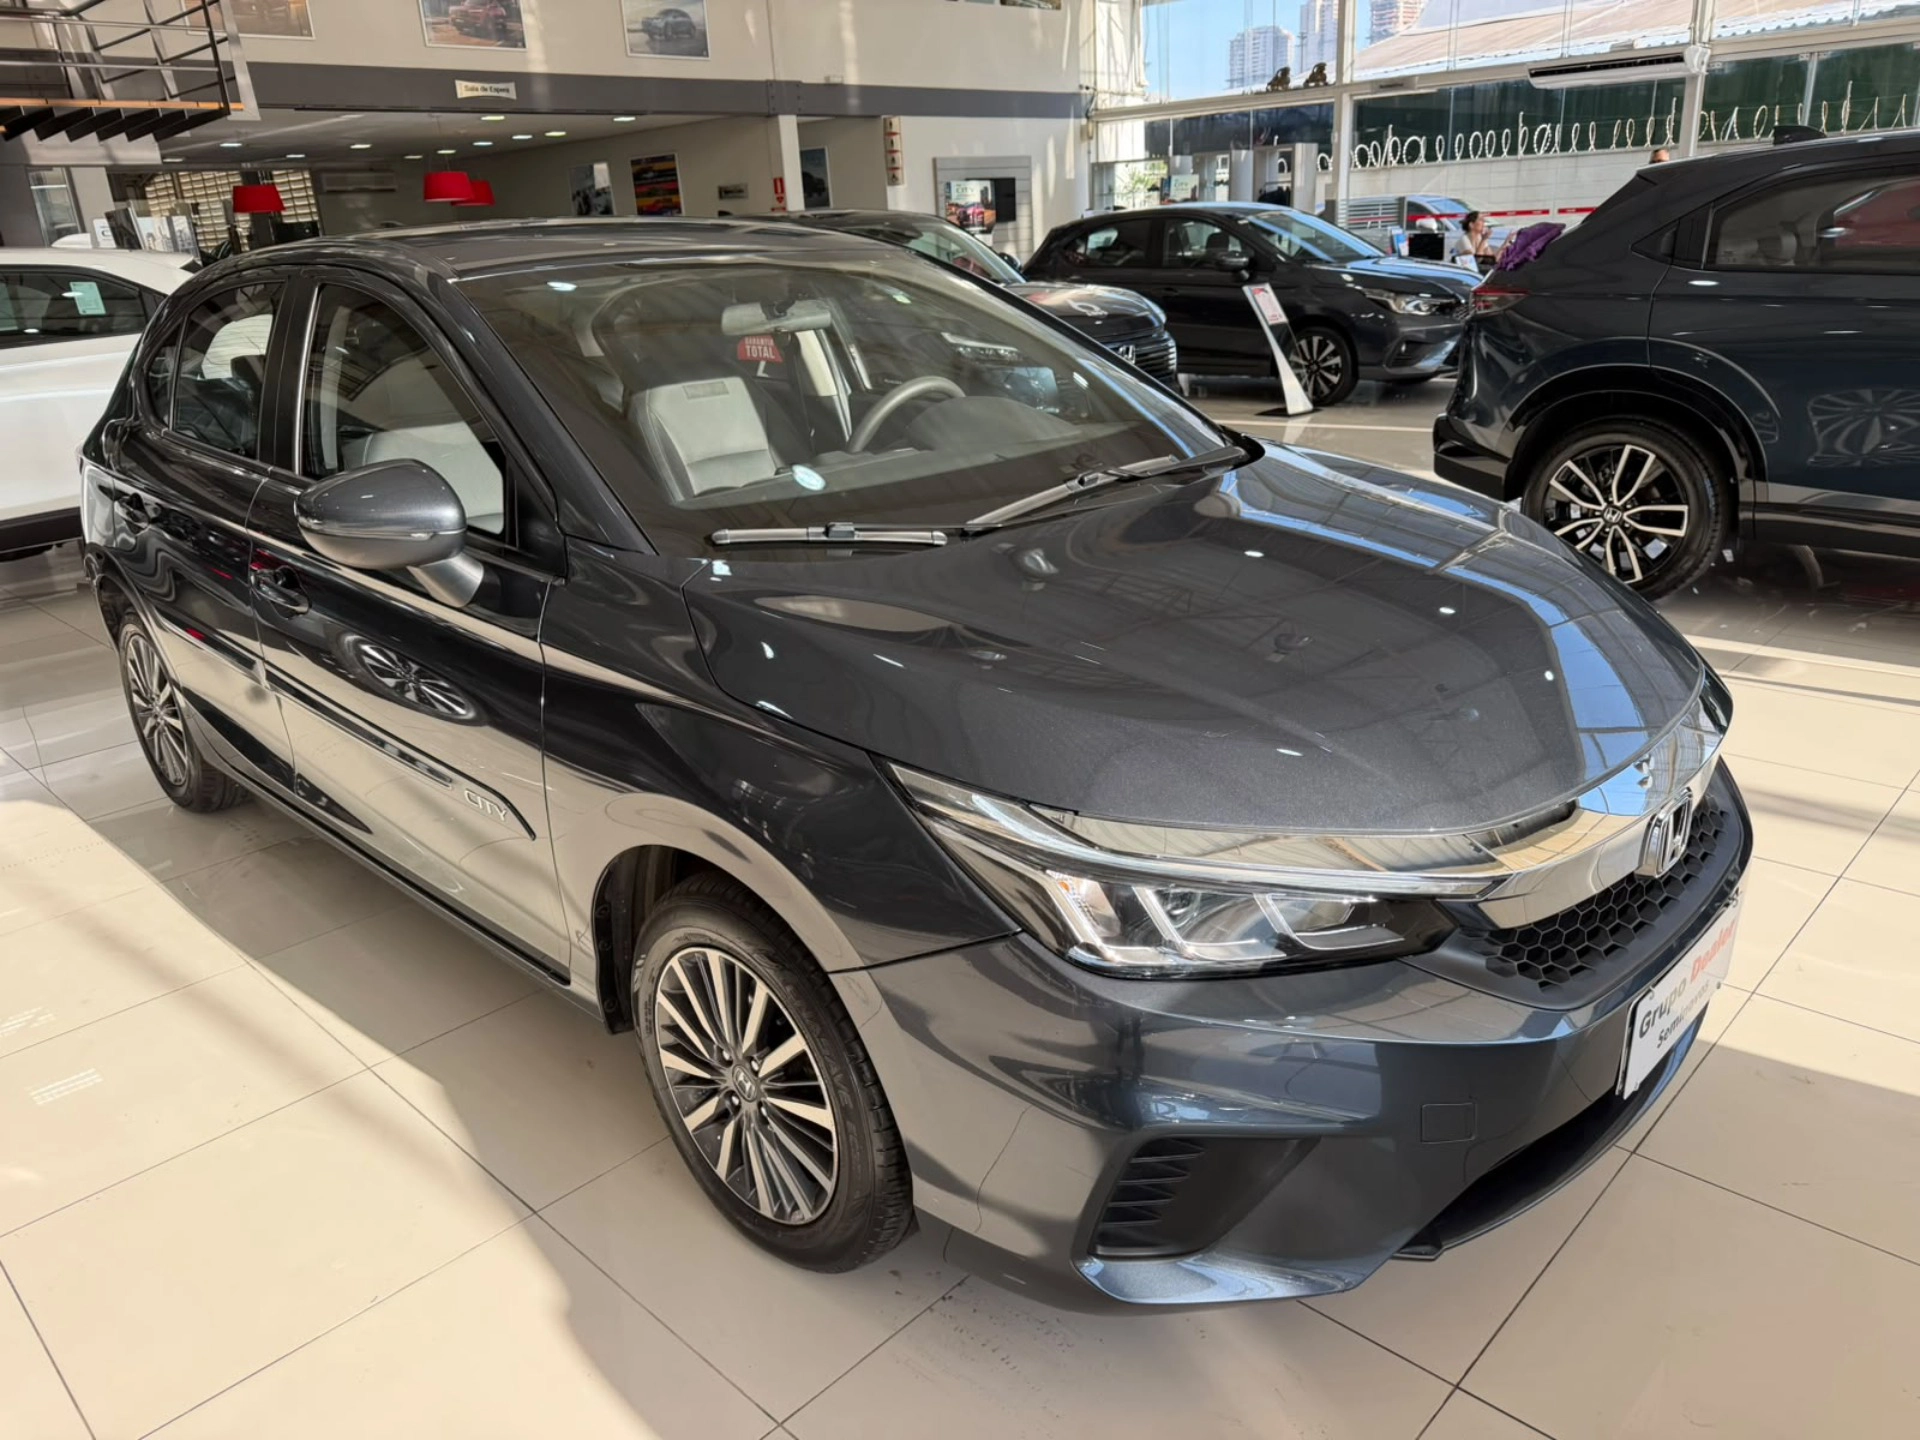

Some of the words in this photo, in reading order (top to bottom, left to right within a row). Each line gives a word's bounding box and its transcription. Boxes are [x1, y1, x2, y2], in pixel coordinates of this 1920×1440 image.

[745, 345, 776, 359] TOTAL
[464, 788, 507, 821] CITY
[1639, 977, 1687, 1039] Grupo
